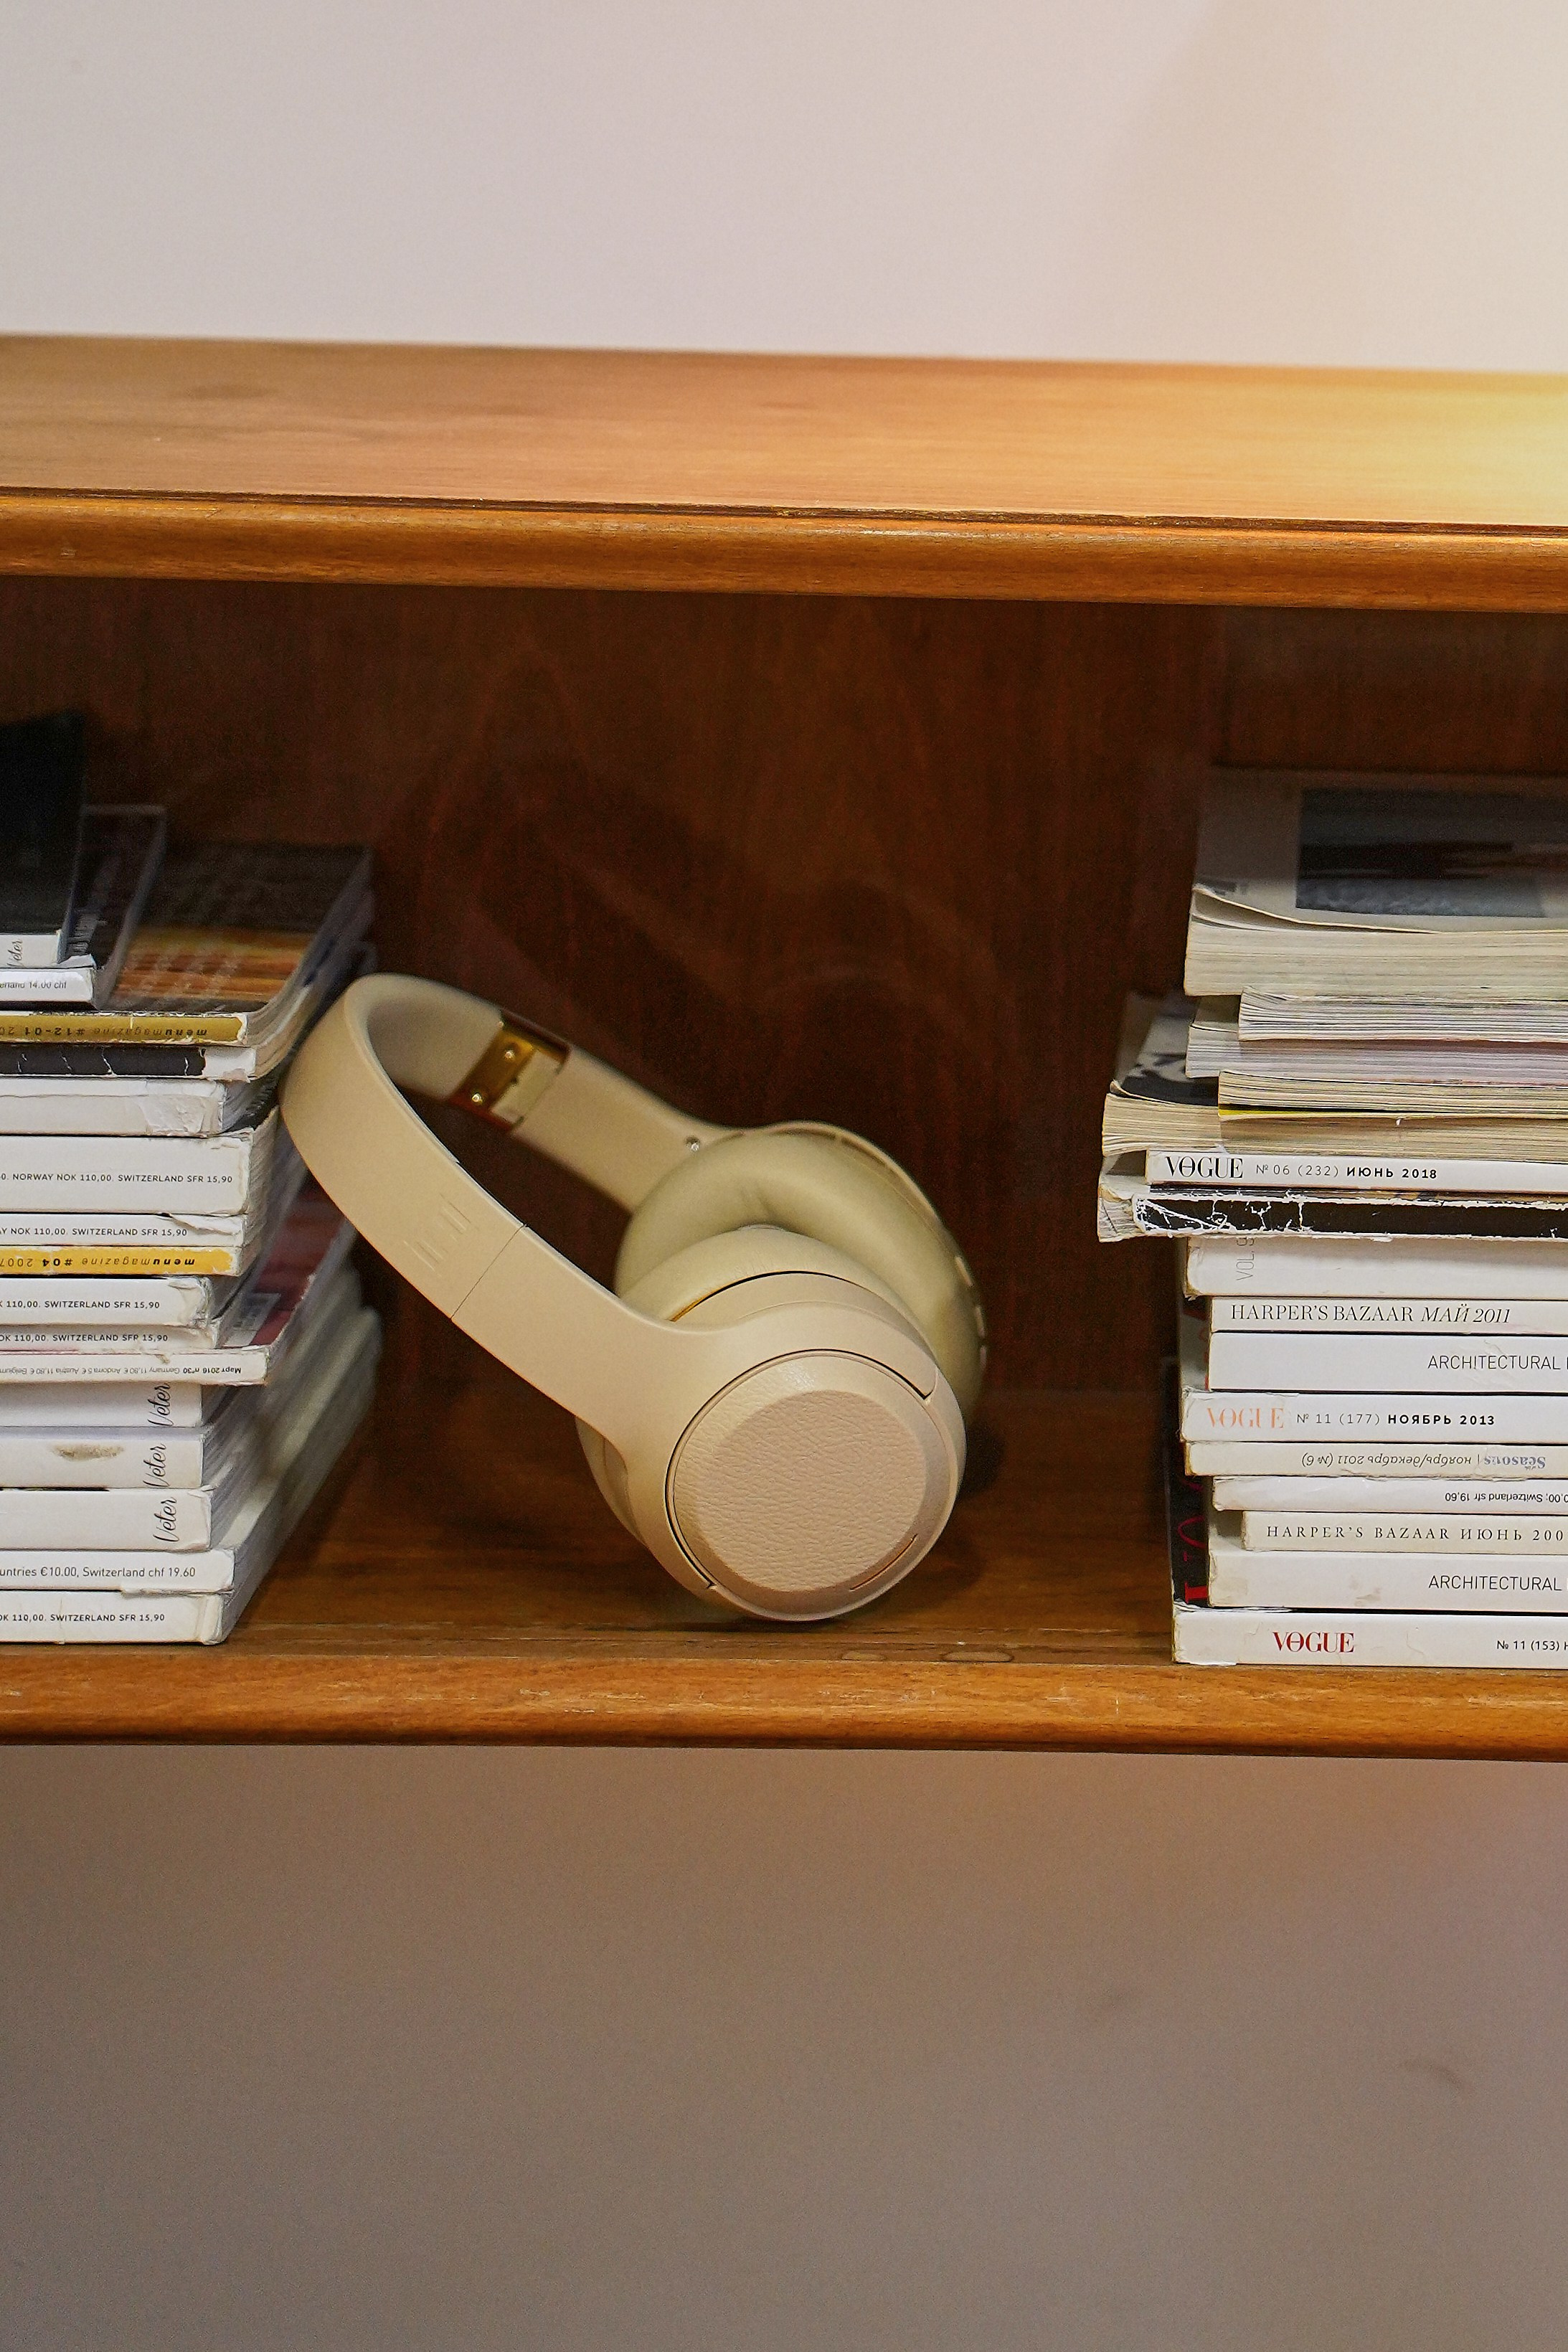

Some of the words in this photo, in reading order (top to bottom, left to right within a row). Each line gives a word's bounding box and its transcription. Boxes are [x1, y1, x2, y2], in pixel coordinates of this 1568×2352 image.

[24, 1027, 85, 1036] #12-01
[1165, 1156, 1244, 1179] VOGUE
[1256, 1163, 1270, 1175] №
[1273, 1164, 1290, 1176] 06
[1298, 1165, 1339, 1178] (232)
[1346, 1166, 1394, 1179] ИЮНЬ
[1402, 1168, 1437, 1179] 2018
[118, 1174, 184, 1183] SWITZERLAND
[207, 1176, 233, 1184] 15,90
[72, 1227, 138, 1237] SWITZERLAND
[82, 1258, 195, 1267] menumagazine
[44, 1300, 110, 1309] SWITZERLAND
[134, 1301, 160, 1310] 15,90
[1231, 1304, 1328, 1321] HARPER'S
[1333, 1305, 1414, 1322] BAZAAR
[1421, 1303, 1470, 1323] МАЙ
[1472, 1307, 1511, 1323] 2011
[142, 1334, 168, 1343] 15,90
[1427, 1354, 1561, 1371] ARCHITECTURAL
[148, 1383, 175, 1427] Veter
[1206, 1407, 1284, 1429] VOGUE
[1296, 1413, 1309, 1425] №
[1316, 1412, 1332, 1425] 11
[1338, 1412, 1381, 1425] (177)
[1387, 1414, 1452, 1425] НОЯБРЬ
[1460, 1414, 1495, 1425] 2013
[143, 1443, 170, 1488] Veter
[1337, 1455, 1364, 1466] 2011
[1445, 1491, 1470, 1502] 19,60
[1474, 1492, 1486, 1502] sfr
[1488, 1492, 1543, 1503] Switzerland
[153, 1497, 179, 1542] Veter
[1267, 1526, 1364, 1538] HARPER'S
[1374, 1527, 1450, 1540] BAZAAR
[1460, 1529, 1522, 1541] ИЮНЬ
[1532, 1529, 1564, 1541] 200
[83, 1567, 145, 1577] Switzerland
[148, 1567, 165, 1577] chf
[169, 1567, 196, 1577] 19.60
[1428, 1574, 1562, 1591] ARCHITECTURAL
[139, 1614, 165, 1623] 15,90
[1272, 1631, 1355, 1653] VOGUE
[1496, 1640, 1509, 1650] №
[1513, 1640, 1526, 1650] 11
[1531, 1640, 1560, 1653] (153)
